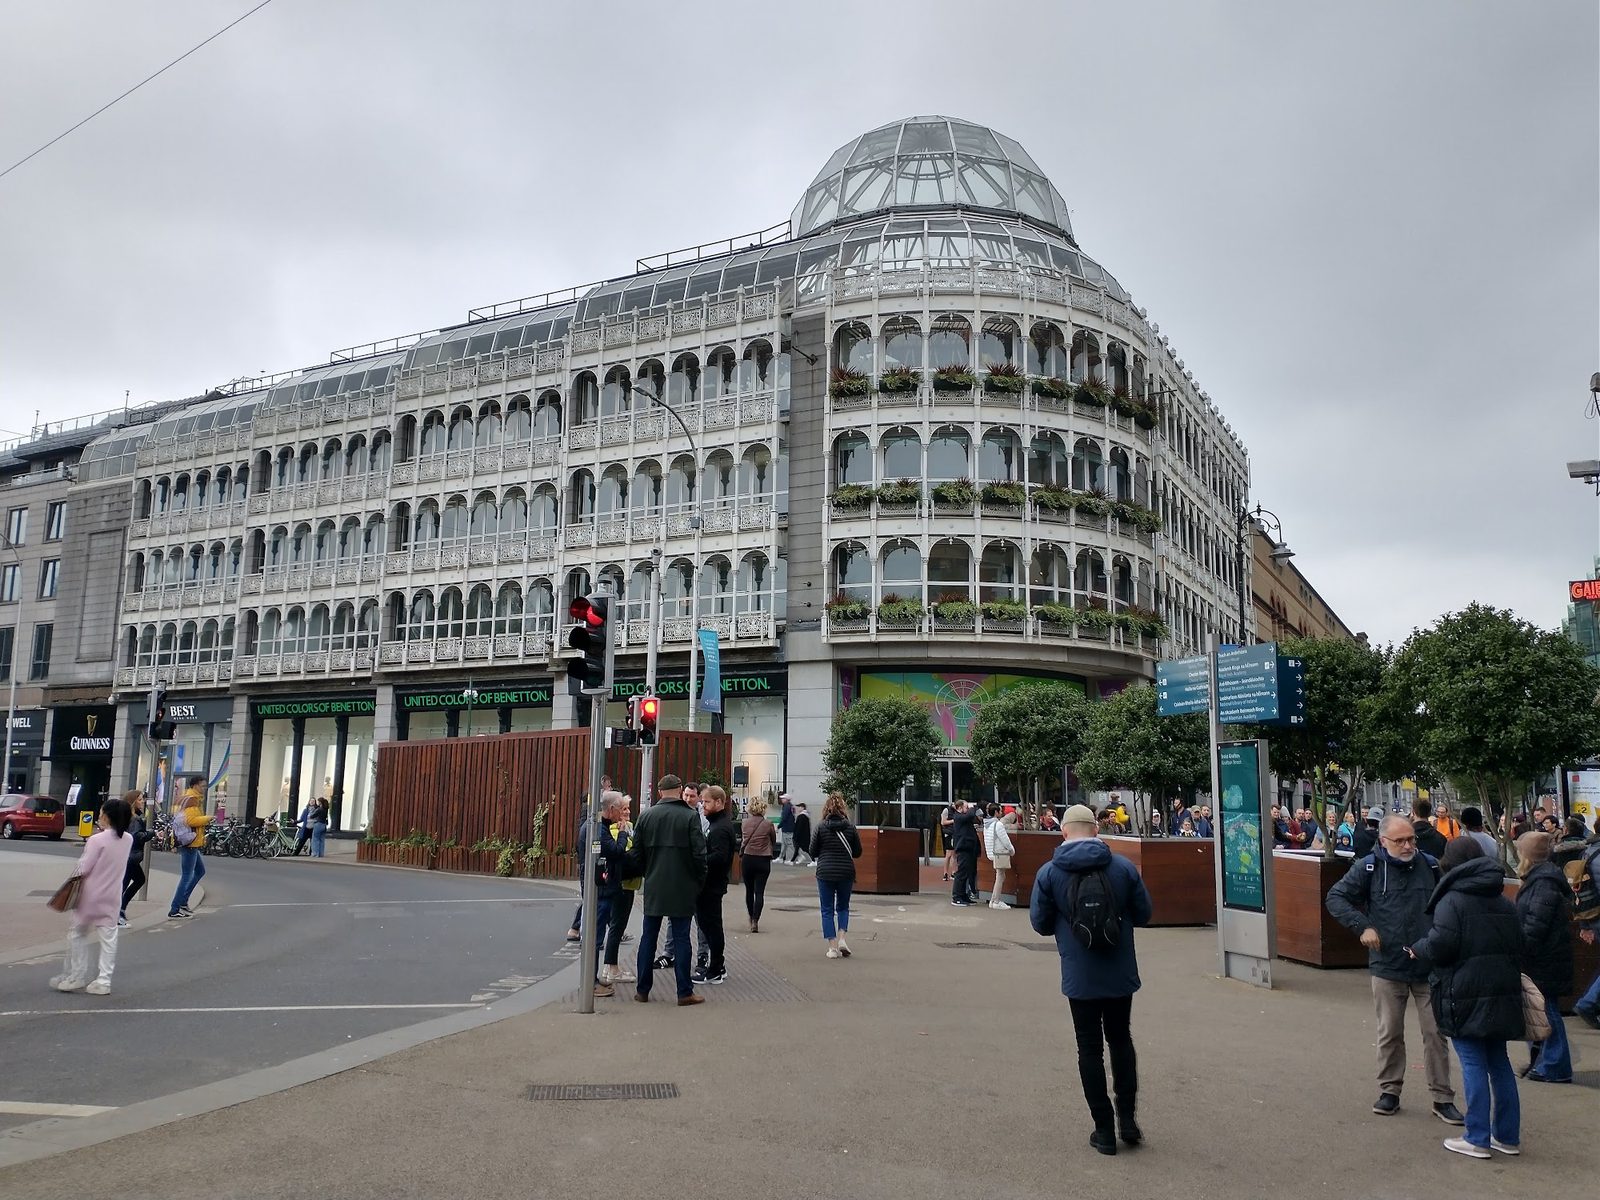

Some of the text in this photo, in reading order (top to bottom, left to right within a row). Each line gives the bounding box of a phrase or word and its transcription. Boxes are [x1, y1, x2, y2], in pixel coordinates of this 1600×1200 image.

[404, 695, 438, 707] UNITED
[479, 693, 493, 704] OF
[170, 705, 195, 716] BEST
[257, 701, 375, 715] UNITED COLORS OF BENETTON
[70, 736, 110, 750] GUINNESS
